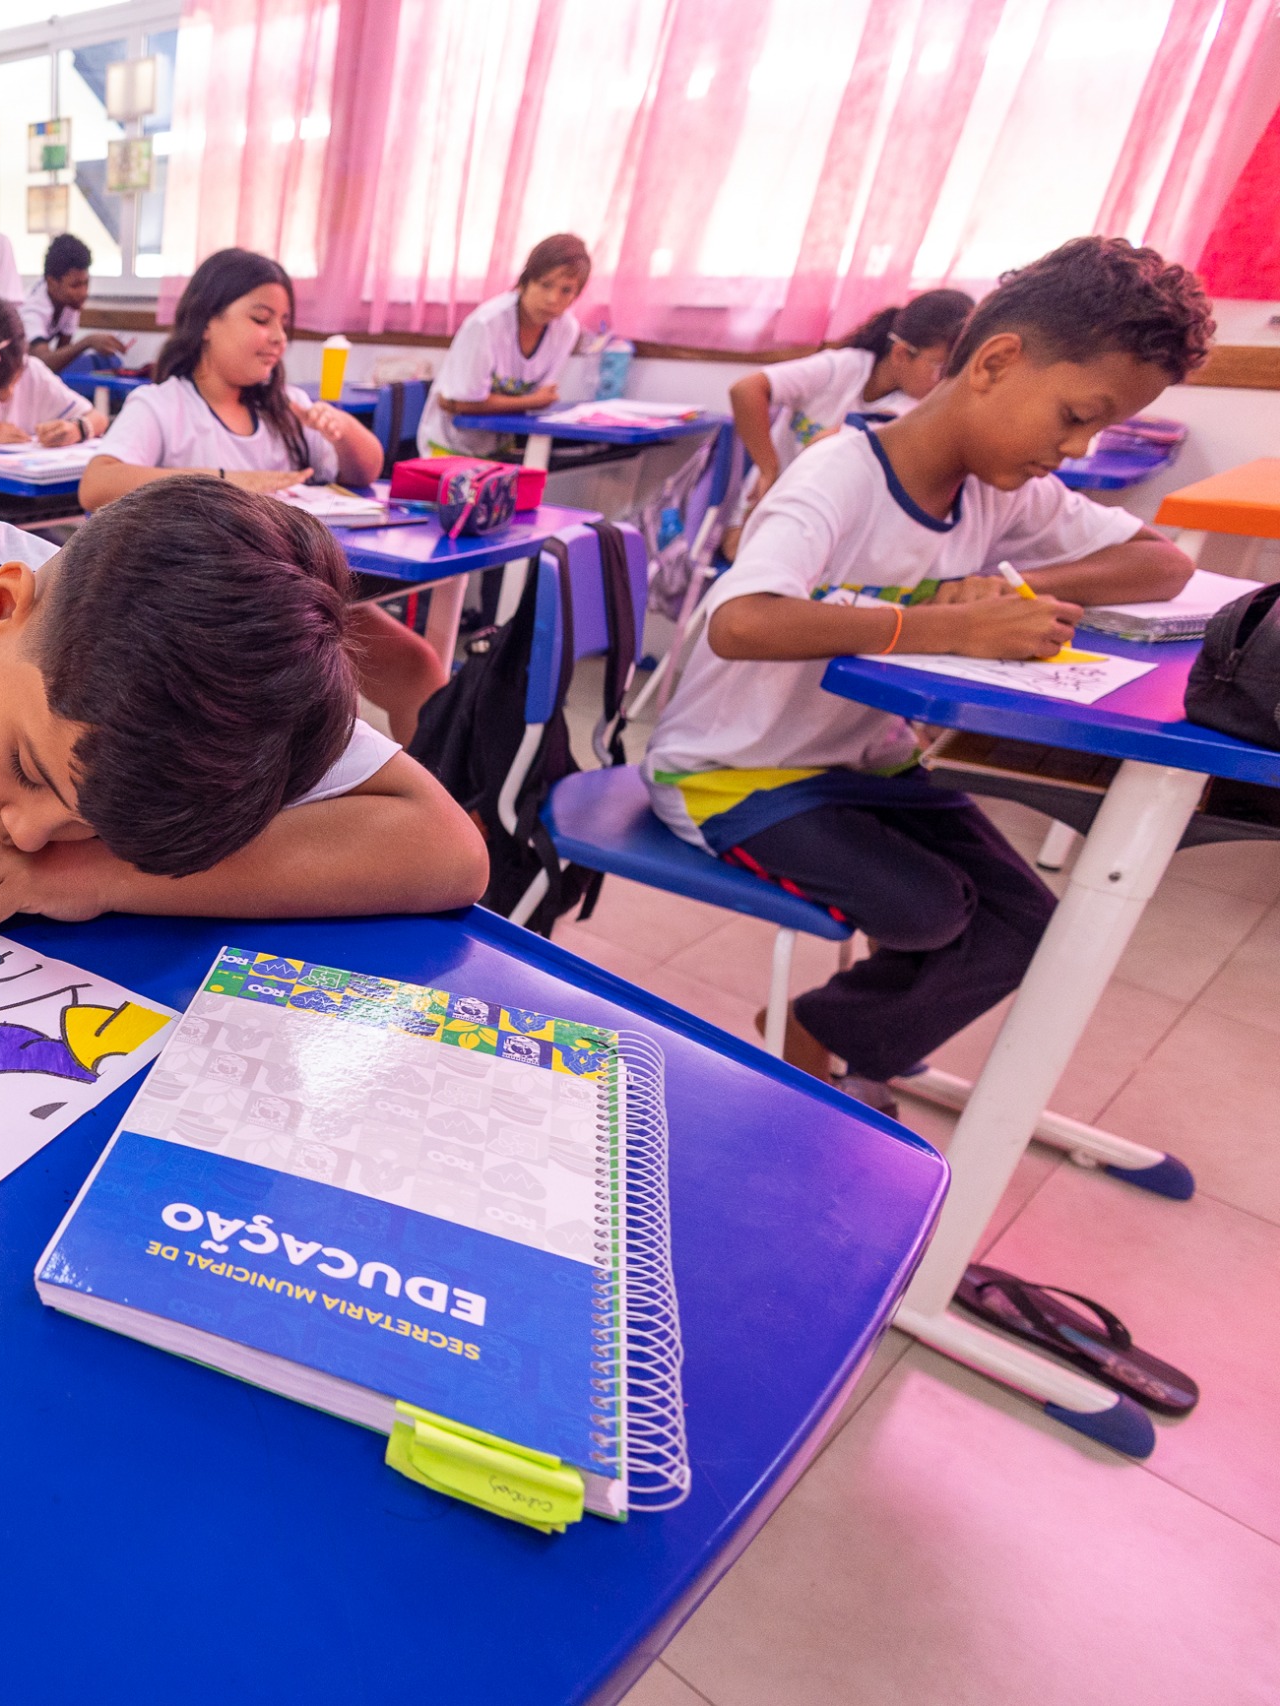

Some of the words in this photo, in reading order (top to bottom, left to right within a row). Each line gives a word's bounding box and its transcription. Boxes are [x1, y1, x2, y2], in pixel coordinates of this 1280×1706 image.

[147, 1241, 180, 1262] DE
[160, 1201, 488, 1328] EDUCAÇÃO
[185, 1251, 317, 1305] MUNICIPAL
[321, 1294, 482, 1361] SECRETARIA
